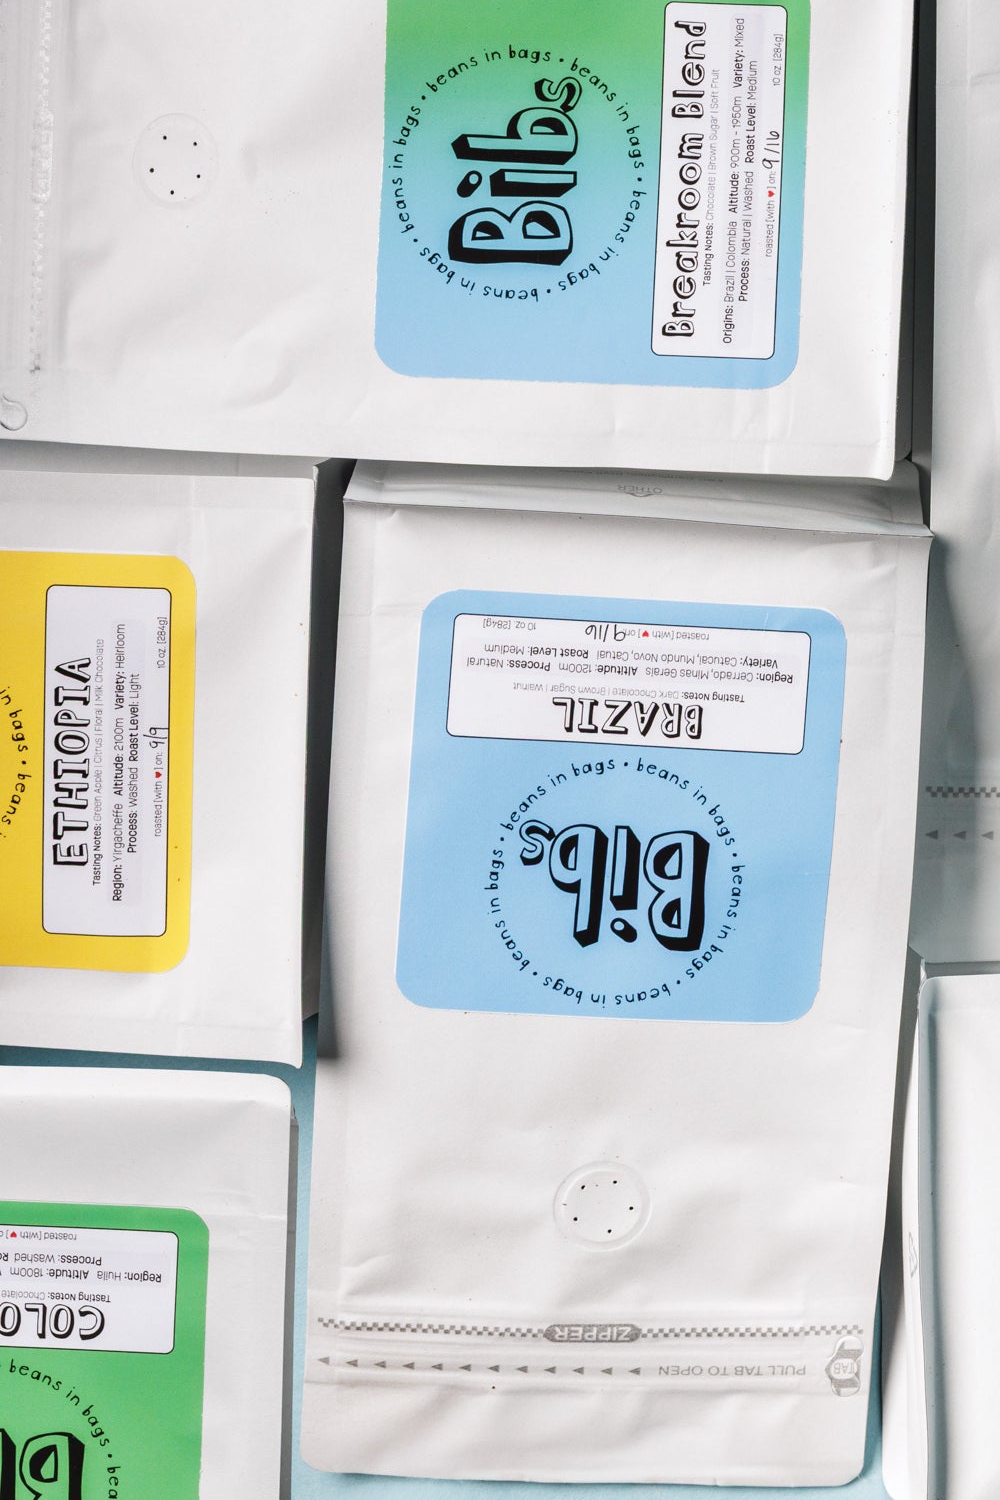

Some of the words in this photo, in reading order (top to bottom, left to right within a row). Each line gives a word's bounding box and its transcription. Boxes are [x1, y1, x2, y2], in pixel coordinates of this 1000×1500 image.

[671, 20, 706, 118] Blend
[762, 130, 779, 169] 9/16
[448, 77, 582, 266] Bibs
[662, 132, 704, 337] Breakroom
[585, 624, 626, 642] 9/16
[129, 673, 142, 698] Light
[128, 701, 139, 730] Level:
[552, 696, 703, 739] BRAZIL
[128, 732, 138, 761] Roast
[143, 727, 167, 748] 9/9
[52, 657, 91, 866] ETHIOPIA
[127, 767, 138, 807] Washed
[637, 758, 689, 789] beans
[692, 786, 707, 806] in
[708, 804, 736, 846] bags
[126, 810, 137, 853] Process:
[519, 820, 710, 951] Bibs
[9, 1266, 43, 1277] 1800m
[45, 1266, 92, 1280] Altitude:
[96, 1269, 121, 1281] Huila
[123, 1269, 161, 1283] Region:
[555, 1325, 632, 1342] ZIPPER
[658, 1365, 702, 1376] OPEN
[708, 1365, 729, 1376] TO
[734, 1365, 763, 1376] TAB
[768, 1365, 807, 1376] PULL
